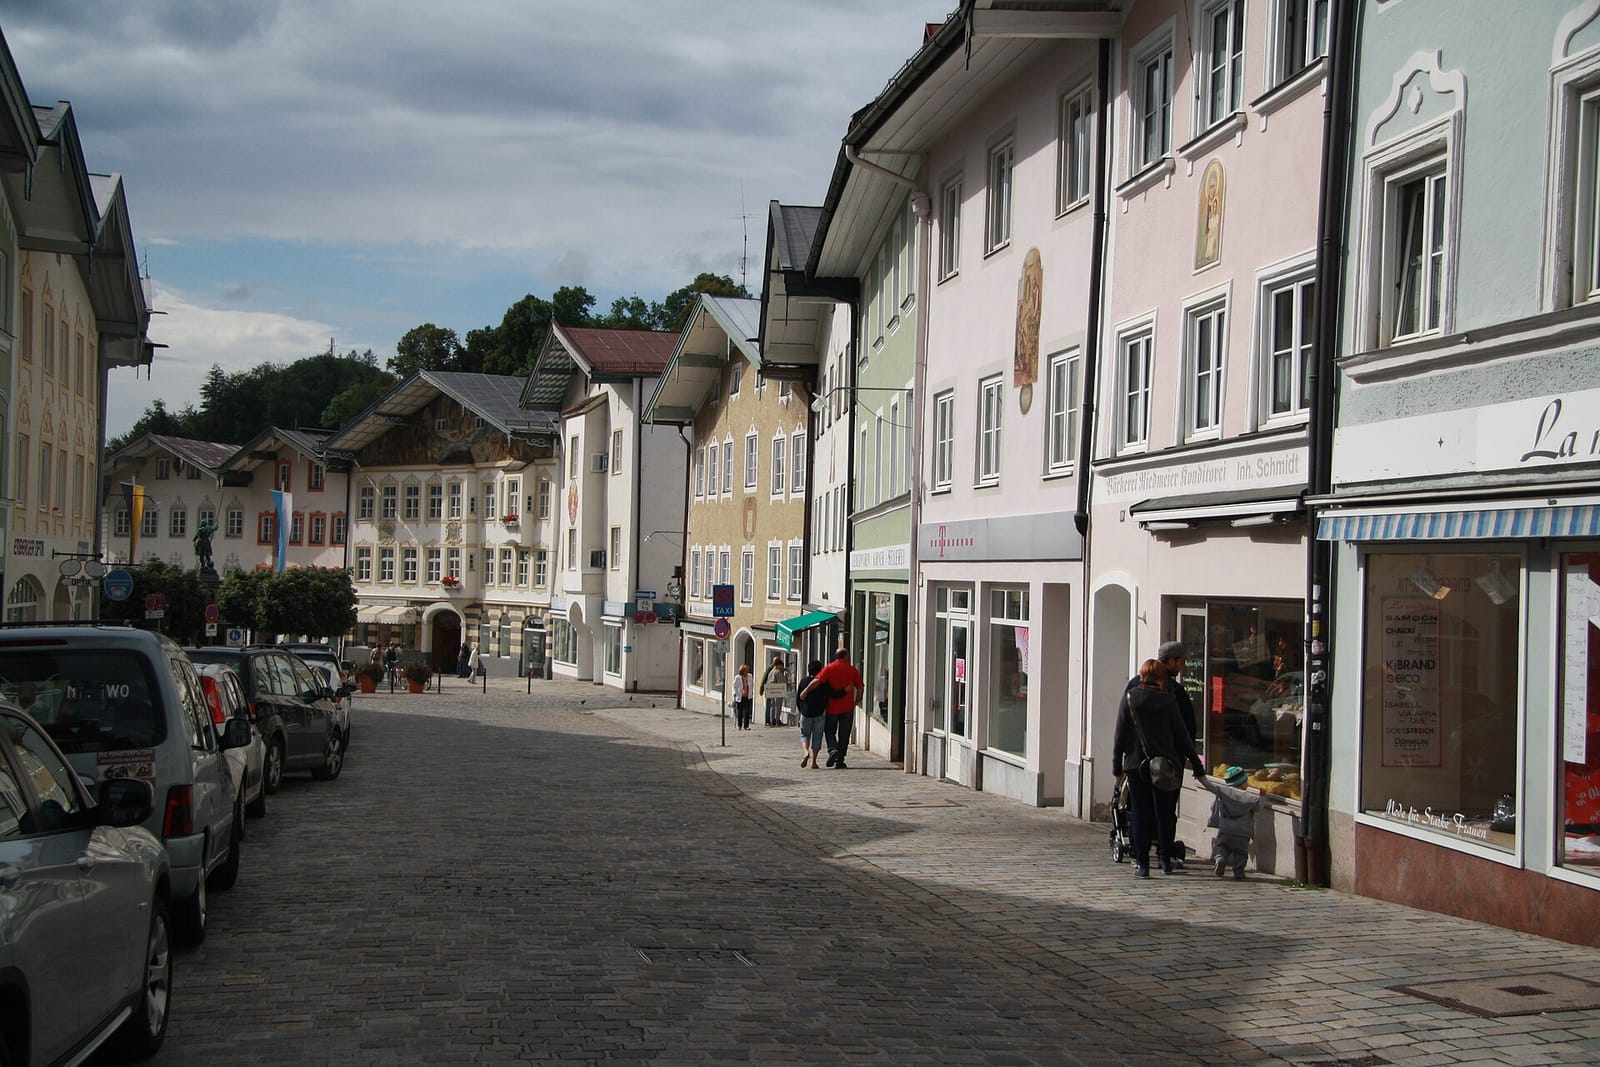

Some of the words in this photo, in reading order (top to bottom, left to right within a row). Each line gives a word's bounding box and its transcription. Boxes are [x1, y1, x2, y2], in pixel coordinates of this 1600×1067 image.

[1519, 398, 1578, 463] La
[1180, 461, 1227, 484] Konditorei
[1236, 461, 1254, 481] Inh.
[1256, 453, 1299, 478] Schmidt
[715, 606, 733, 615] TAXI
[1380, 798, 1406, 818] Mode
[1407, 805, 1420, 824] für
[1452, 812, 1487, 839] Frauen
